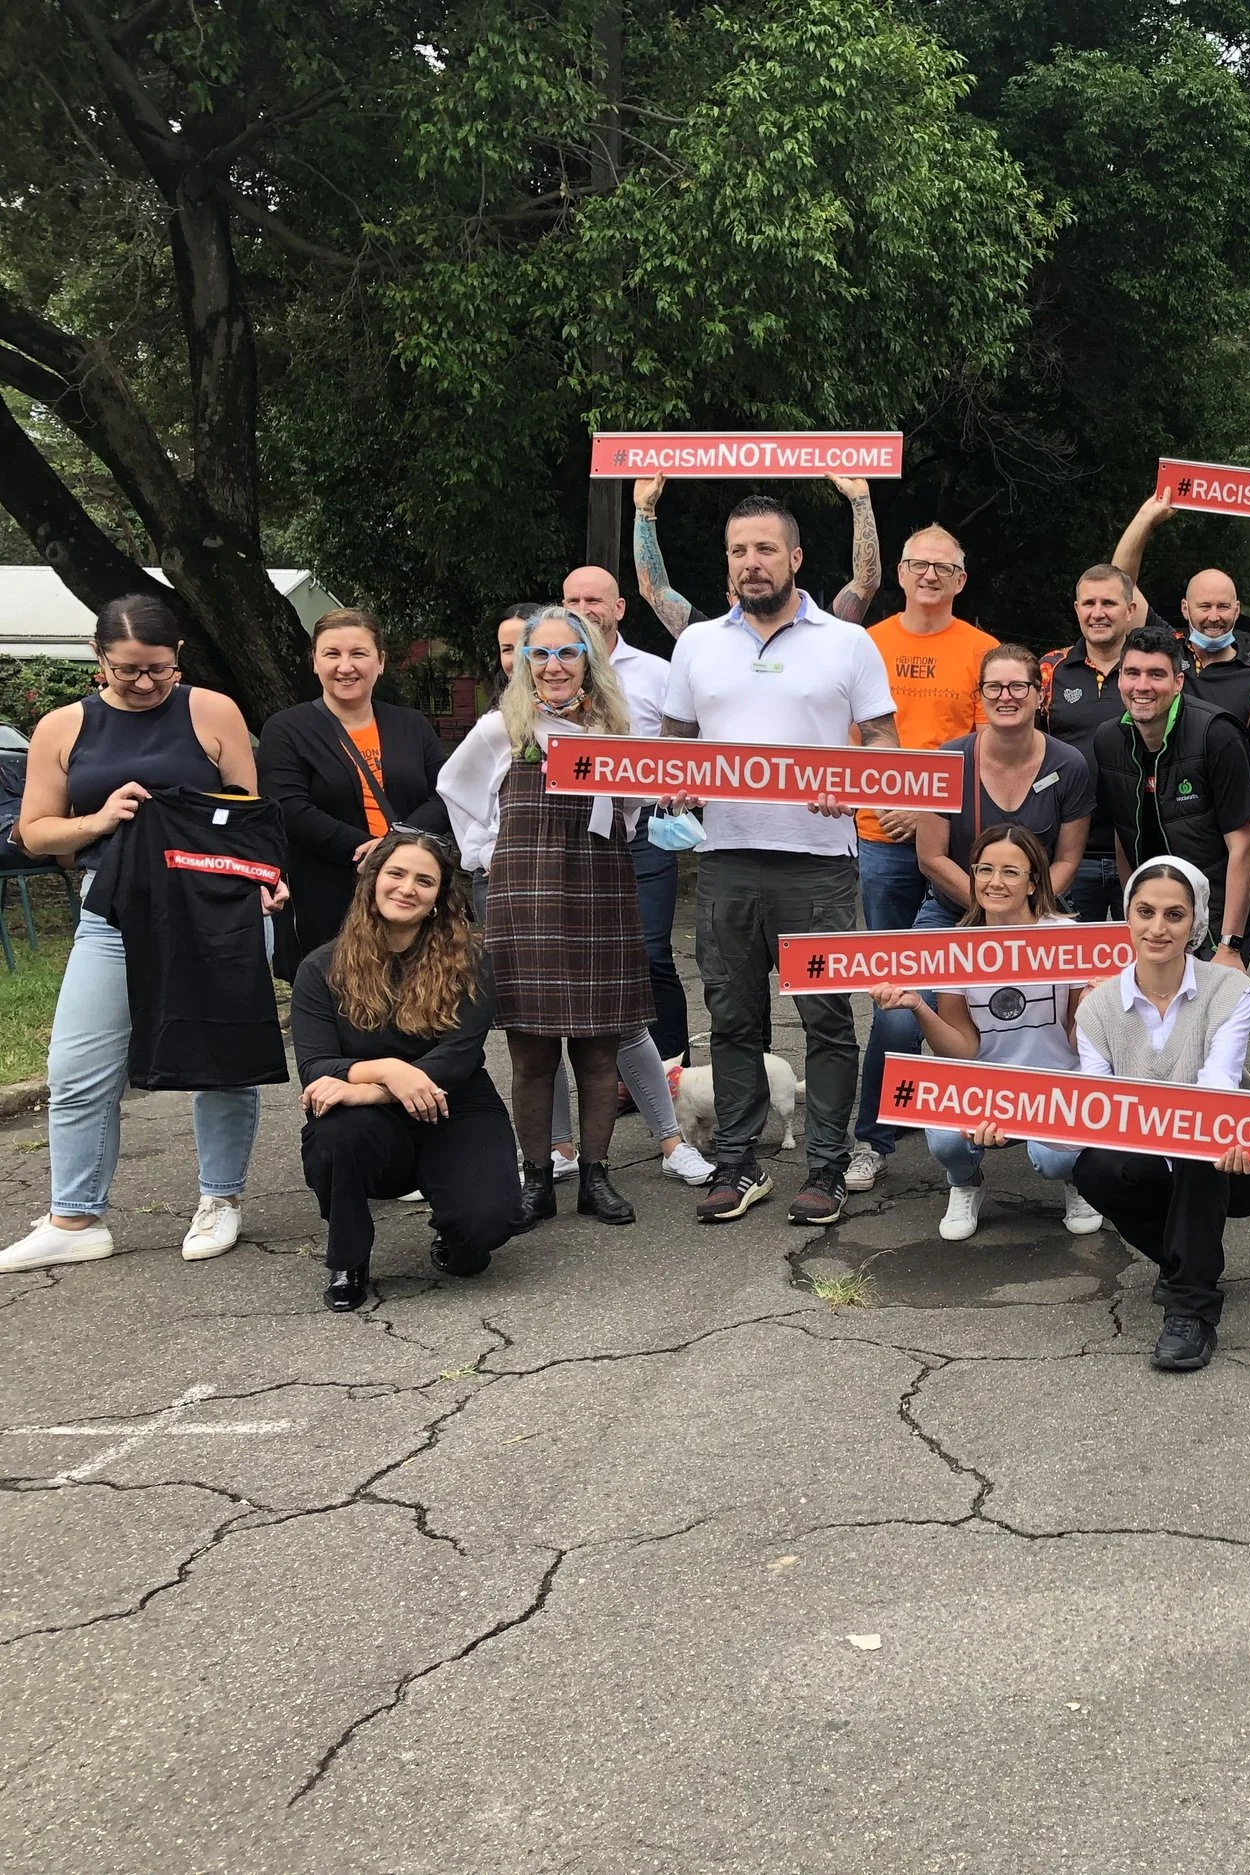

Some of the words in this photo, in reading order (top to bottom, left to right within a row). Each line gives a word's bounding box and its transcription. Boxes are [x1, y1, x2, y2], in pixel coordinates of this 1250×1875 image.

[613, 443, 893, 467] #RACISMNOTWELCOME
[896, 664, 936, 679] WEEK
[573, 755, 949, 798] #RACISMNOTWELCOME
[169, 855, 277, 880] #ACISMNOTWELCOME
[807, 940, 1134, 979] #RACISMNOTWELCO
